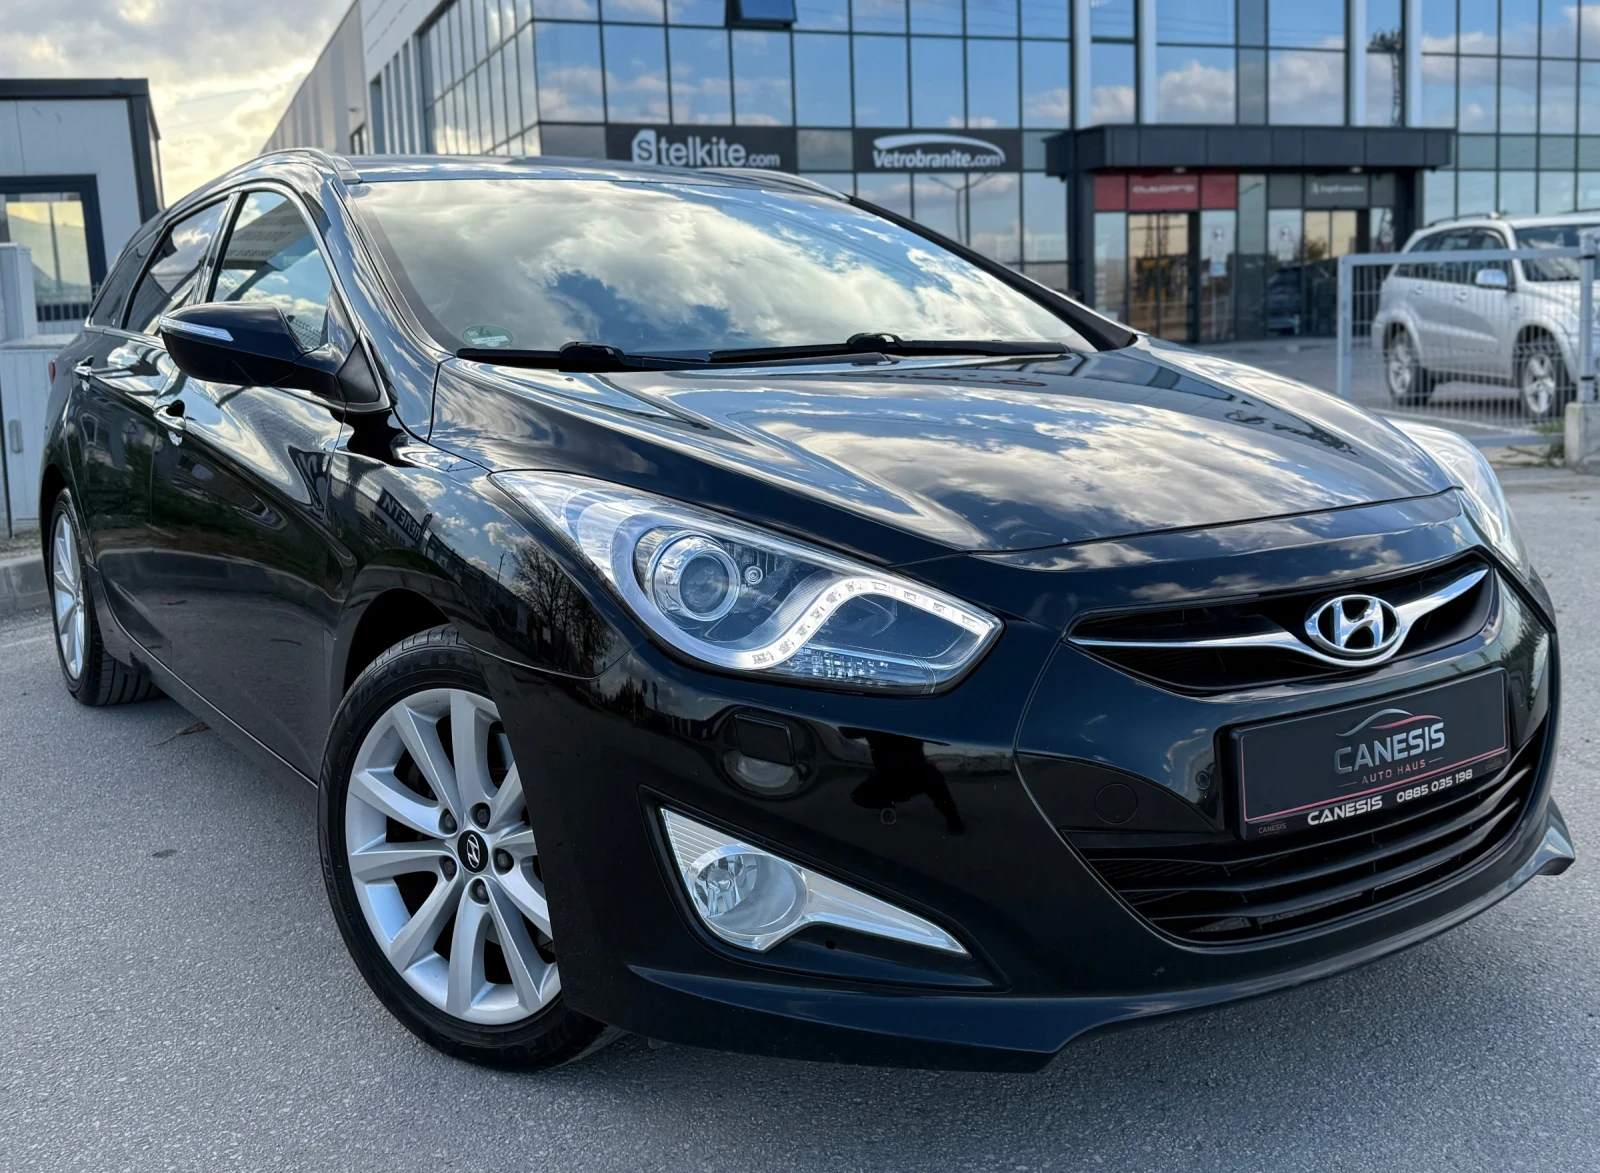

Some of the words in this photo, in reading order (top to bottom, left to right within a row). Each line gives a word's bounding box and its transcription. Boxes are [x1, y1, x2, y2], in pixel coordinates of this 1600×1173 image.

[873, 149, 1001, 168] Vetrobranite.com
[1334, 722, 1445, 774] CANESIS
[1361, 769, 1392, 785] AUTO
[1397, 759, 1426, 775] HAUS
[1307, 796, 1383, 825] CANESIS
[1396, 785, 1429, 803] 0885
[1431, 777, 1453, 792] 035
[1455, 769, 1473, 783] 198
[1258, 823, 1287, 834] CANESIS
